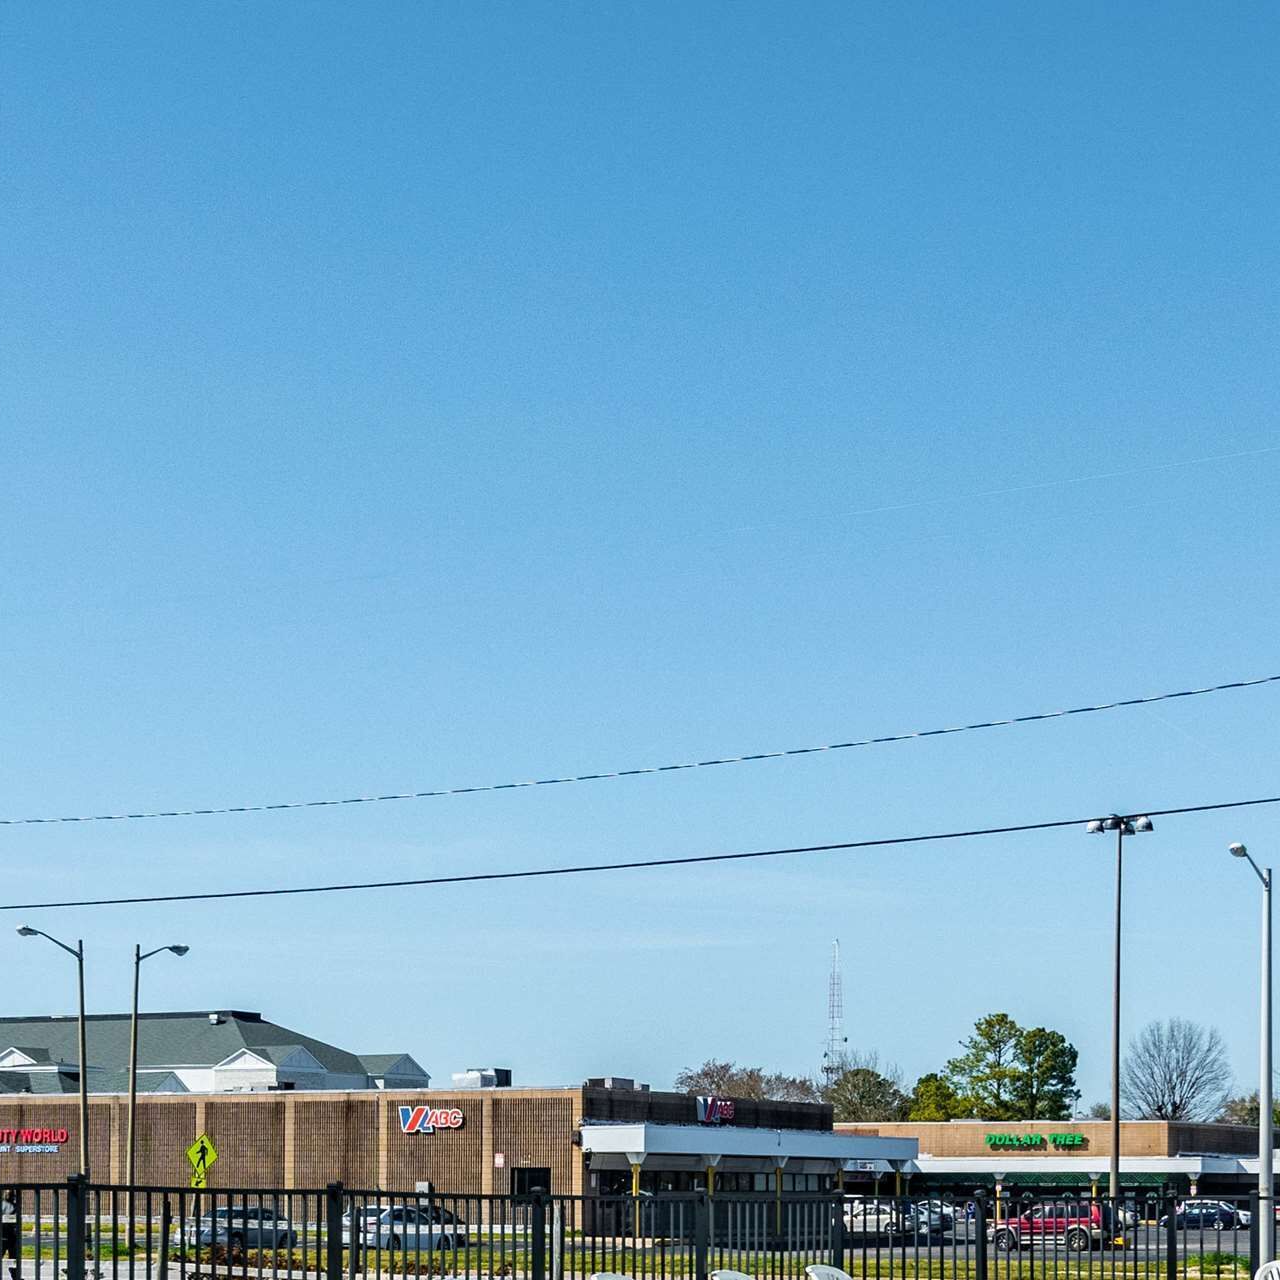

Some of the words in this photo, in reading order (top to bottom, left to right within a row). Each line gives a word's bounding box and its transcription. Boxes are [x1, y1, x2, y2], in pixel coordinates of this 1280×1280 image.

[426, 1109, 463, 1127] ABC
[20, 1128, 68, 1143] WORLD
[985, 1133, 1041, 1144] DOLLAR
[1048, 1133, 1084, 1144] TREE
